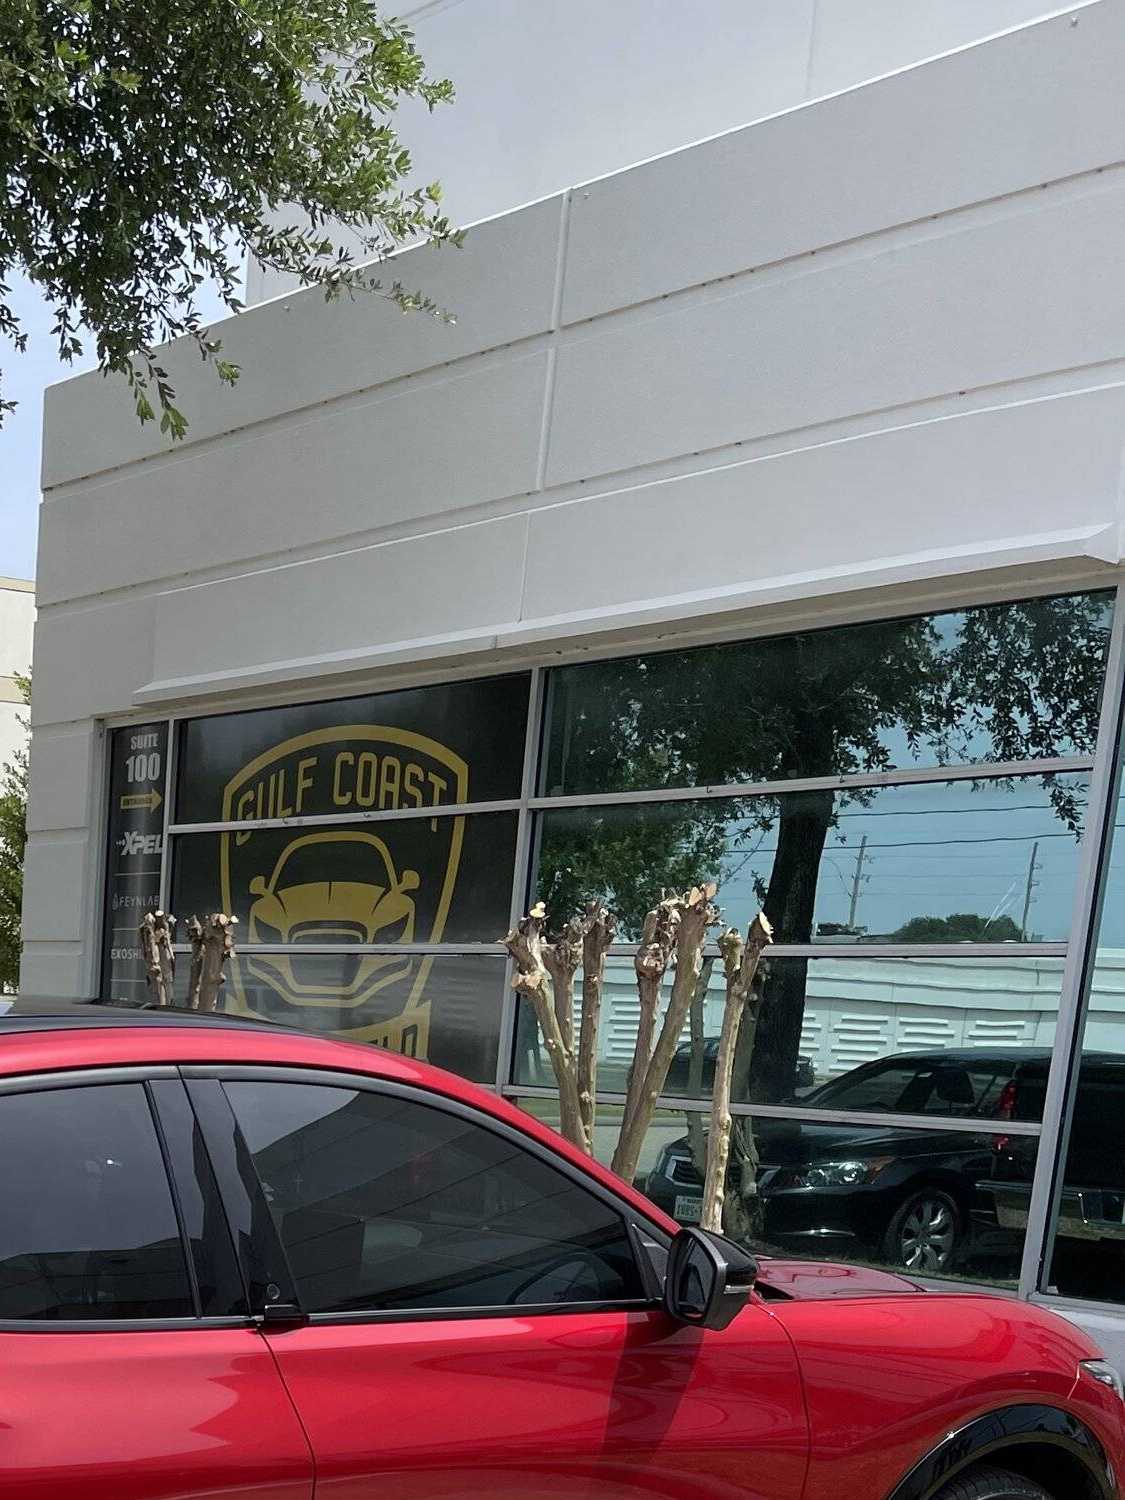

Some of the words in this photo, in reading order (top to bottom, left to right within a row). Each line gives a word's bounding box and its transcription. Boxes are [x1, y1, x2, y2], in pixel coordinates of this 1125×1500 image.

[130, 733, 158, 750] SUITE
[125, 753, 160, 782] 100
[236, 757, 317, 846] GULF
[332, 751, 447, 833] COAST
[121, 831, 163, 856] XPEL
